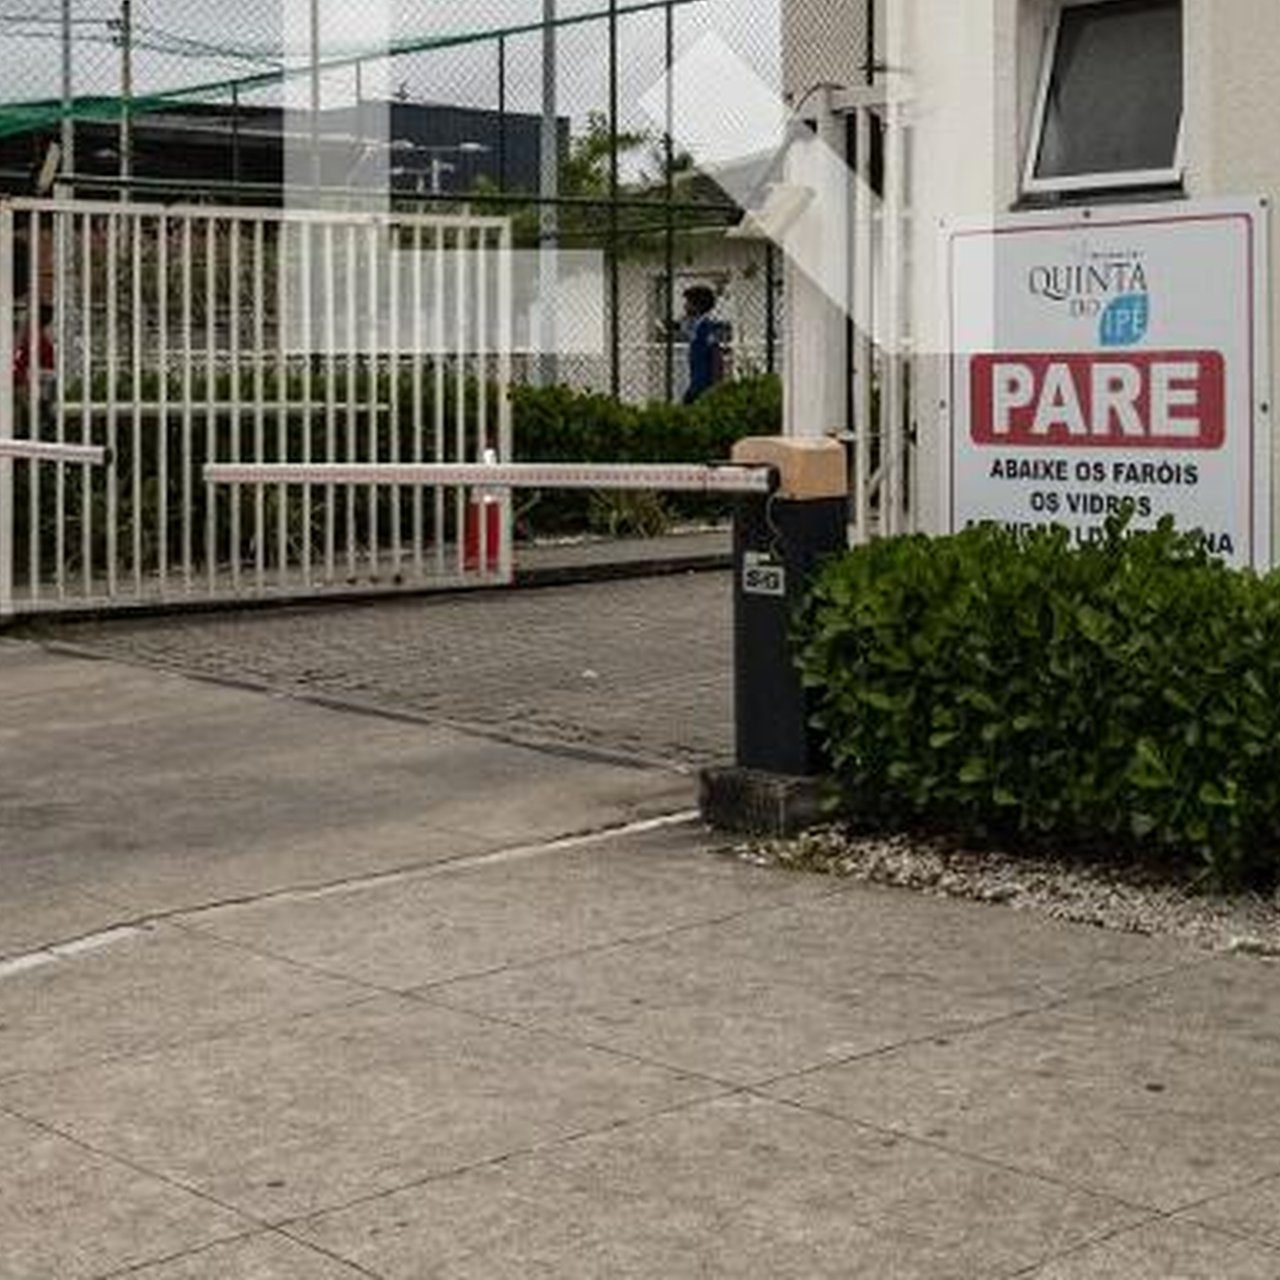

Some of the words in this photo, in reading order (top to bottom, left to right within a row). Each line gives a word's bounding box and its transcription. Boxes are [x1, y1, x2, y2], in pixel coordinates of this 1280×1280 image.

[1029, 262, 1148, 301] QUINTA
[1070, 298, 1101, 318] DO
[991, 362, 1201, 437] PARE
[990, 459, 1068, 481] ABAIXE
[1075, 462, 1106, 482] OS
[1112, 460, 1199, 485] FARÓIS
[1030, 491, 1060, 513] OS
